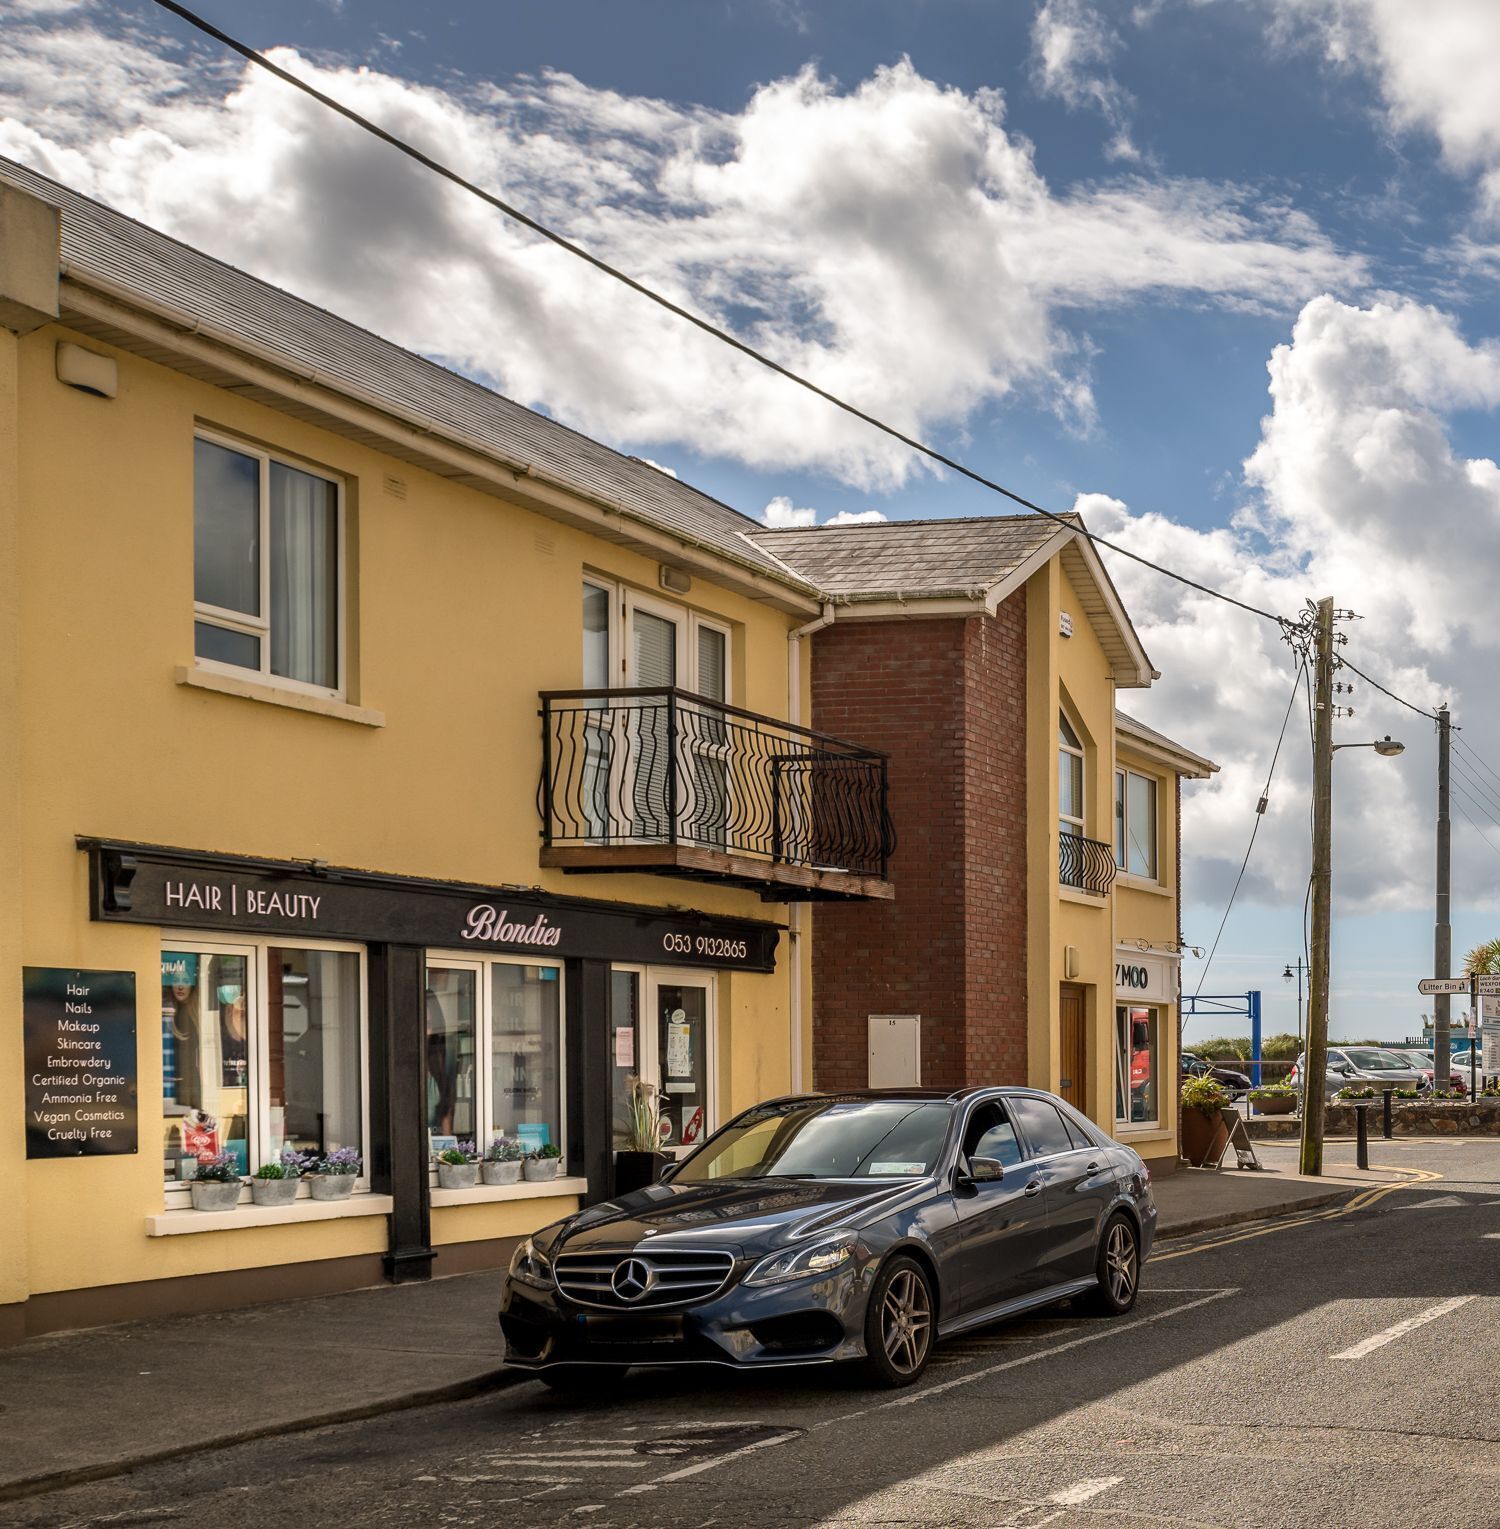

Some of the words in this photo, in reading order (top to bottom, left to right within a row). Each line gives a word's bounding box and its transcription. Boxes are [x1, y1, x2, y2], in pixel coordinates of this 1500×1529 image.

[166, 881, 223, 911] HAIR
[246, 890, 321, 919] BEAUTY
[460, 904, 562, 947] Blondies
[662, 933, 692, 954] 053
[695, 936, 747, 959] 9132865
[66, 984, 91, 996] Hair
[1423, 983, 1443, 991] Litter
[65, 1002, 92, 1014] Nails
[57, 1020, 100, 1034] Makeup
[57, 1037, 102, 1050] Skincare
[32, 1073, 78, 1086] Certified
[82, 1073, 125, 1087] Organic
[41, 1092, 92, 1104] Ammonia
[96, 1091, 117, 1103] Free
[33, 1110, 71, 1125] Vegan
[74, 1109, 125, 1122] Cosmetics
[47, 1128, 87, 1142] Cruelty
[90, 1126, 112, 1138] Free
